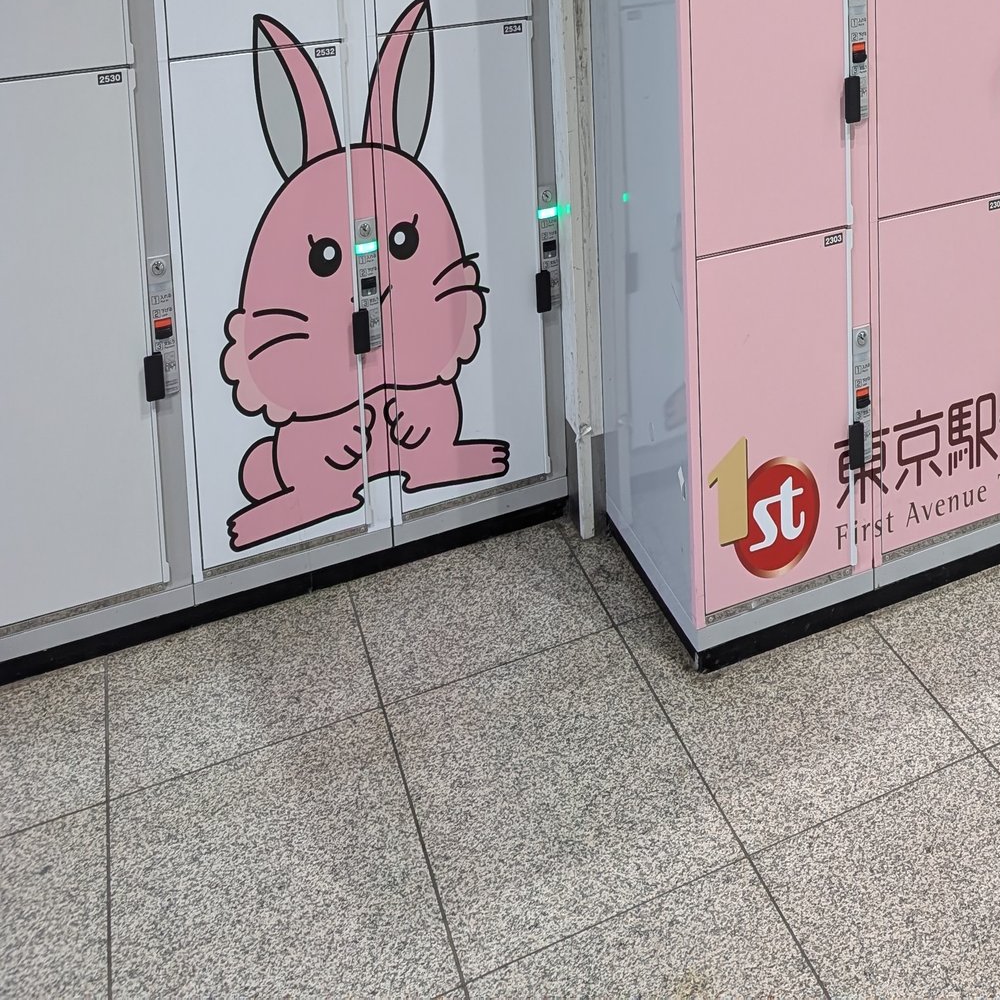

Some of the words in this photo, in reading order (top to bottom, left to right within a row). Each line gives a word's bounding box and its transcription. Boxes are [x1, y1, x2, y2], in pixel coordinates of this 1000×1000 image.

[505, 24, 521, 33] 2534
[315, 47, 336, 57] 2532
[99, 74, 121, 85] 2530
[825, 233, 842, 246] 2303
[835, 511, 894, 550] First
[905, 482, 988, 527] Avenue
